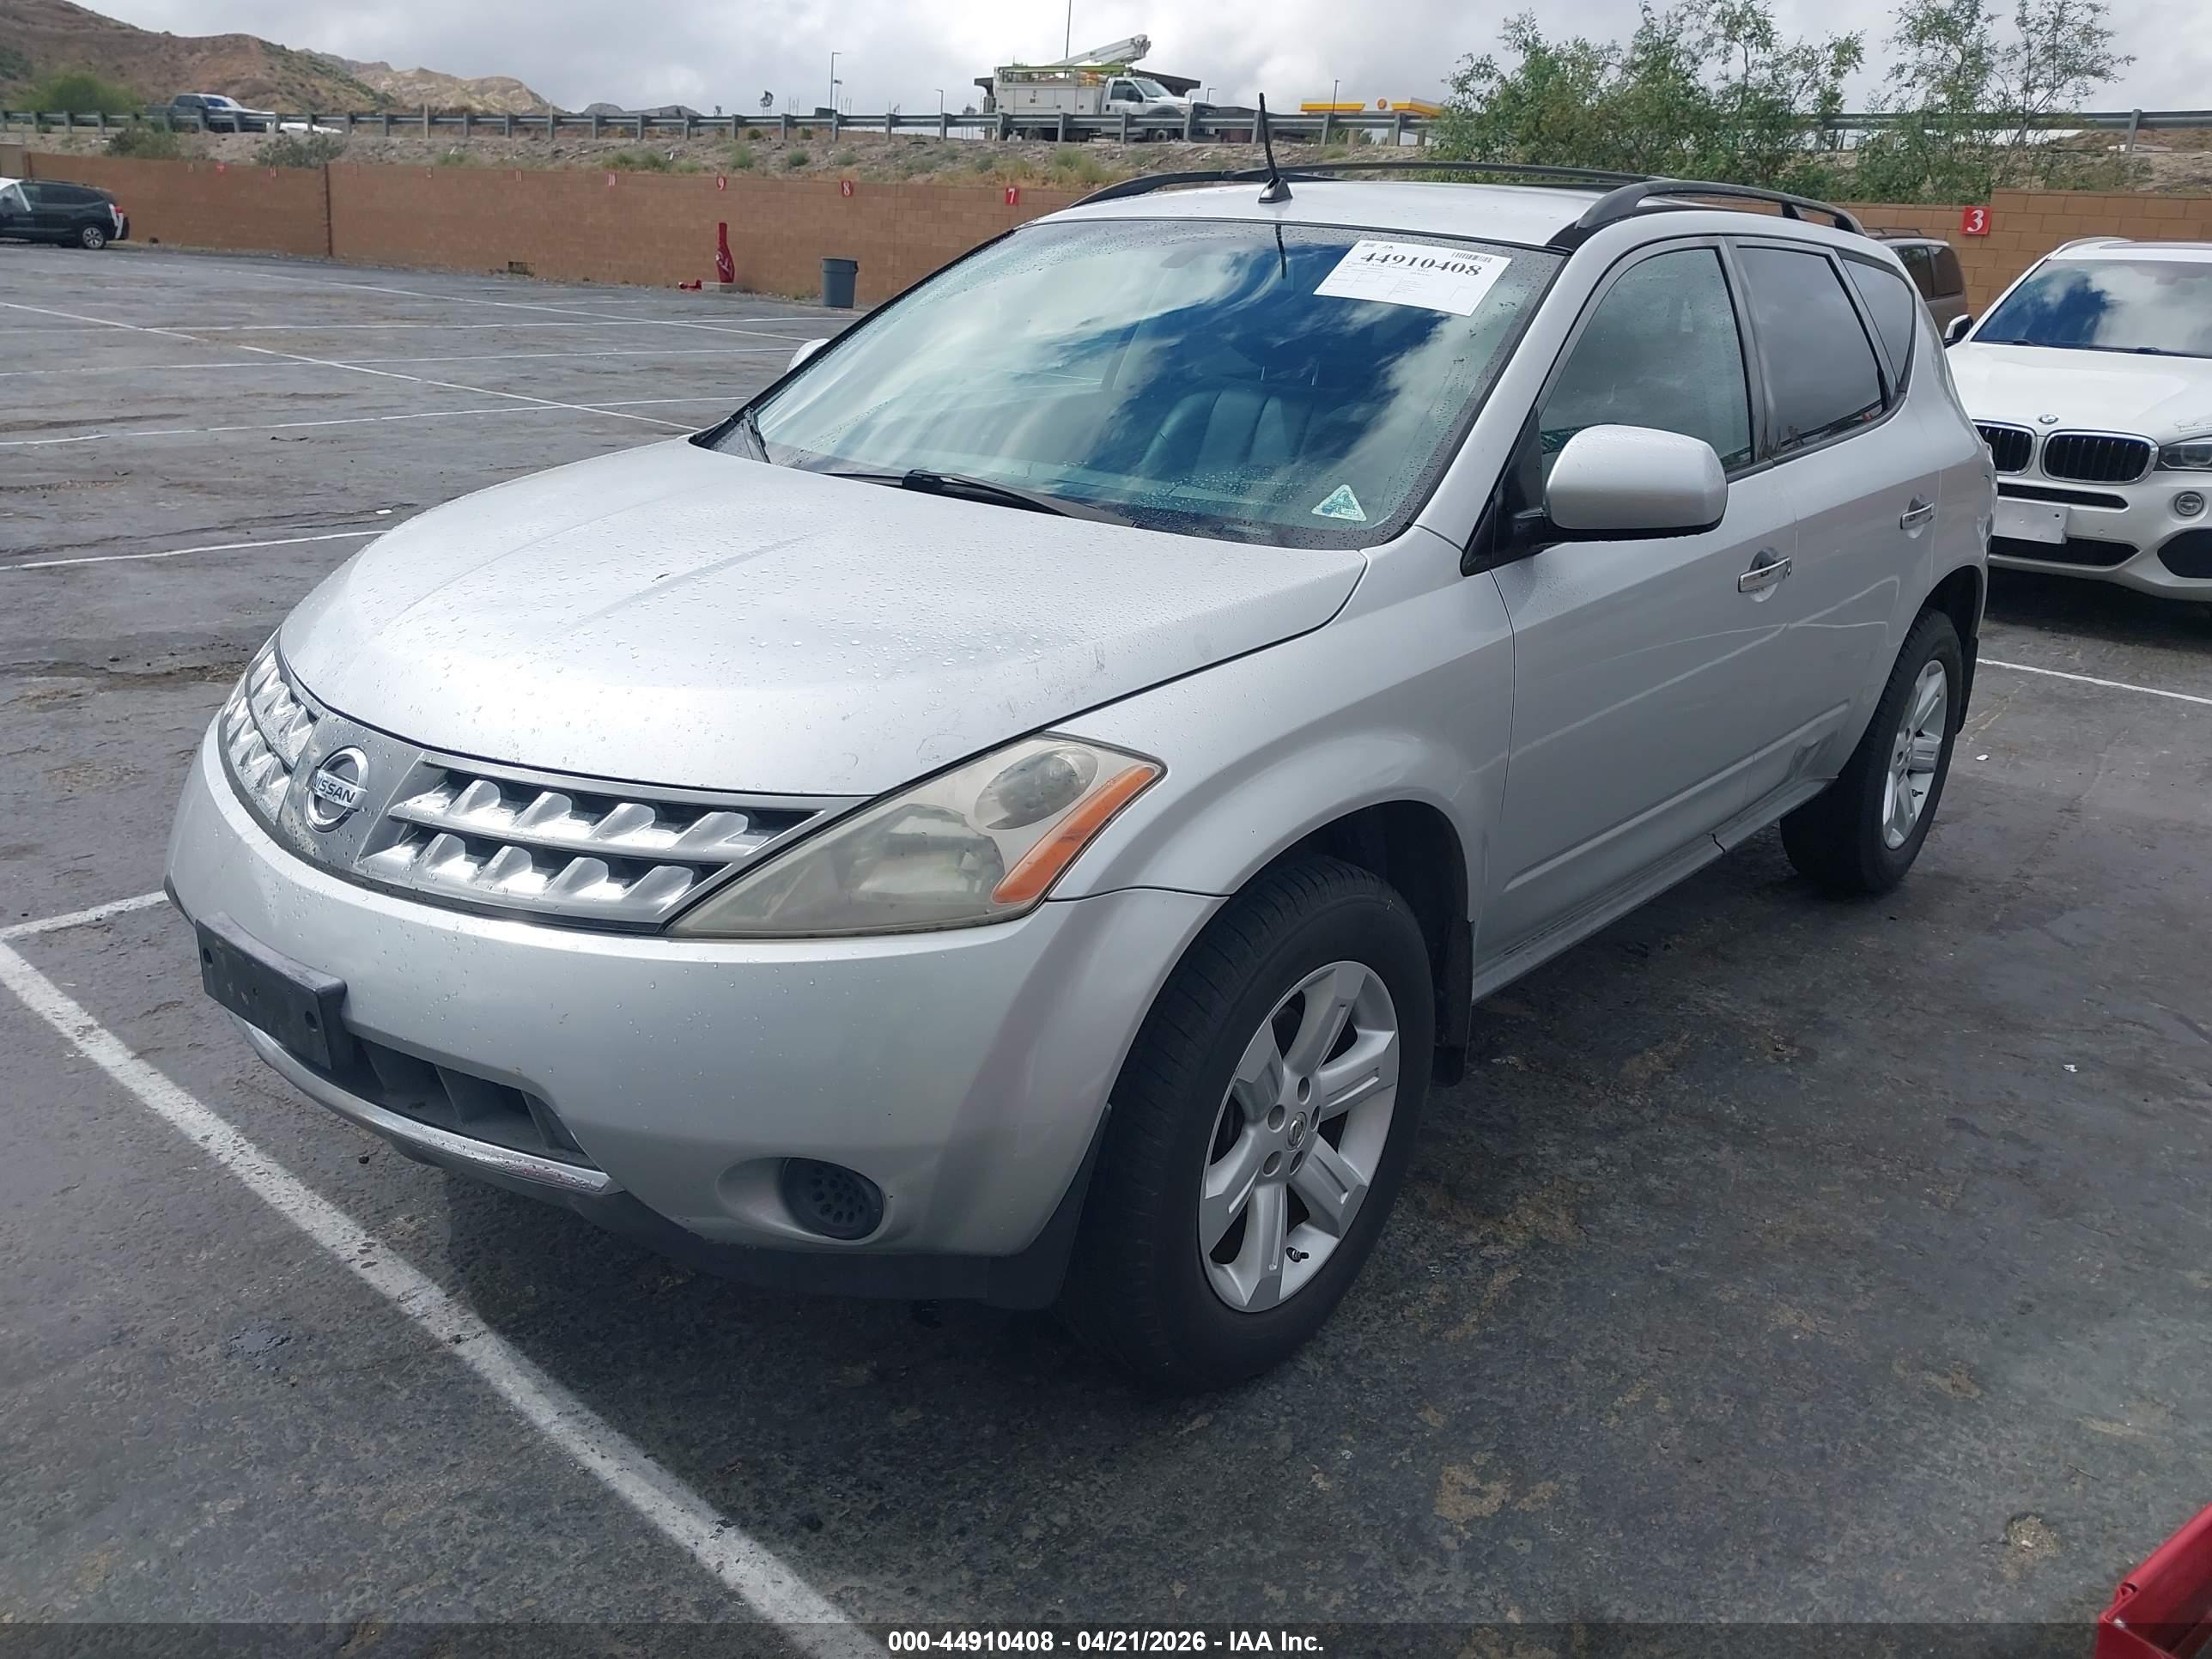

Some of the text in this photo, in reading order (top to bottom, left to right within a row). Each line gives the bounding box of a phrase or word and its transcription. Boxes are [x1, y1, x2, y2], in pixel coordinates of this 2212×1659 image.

[718, 178, 725, 191] 9
[843, 181, 851, 196] 8
[1008, 188, 1016, 204] 7
[1966, 209, 1984, 233] 3
[1360, 252, 1482, 276] 44910408
[313, 776, 356, 803] NISSAN
